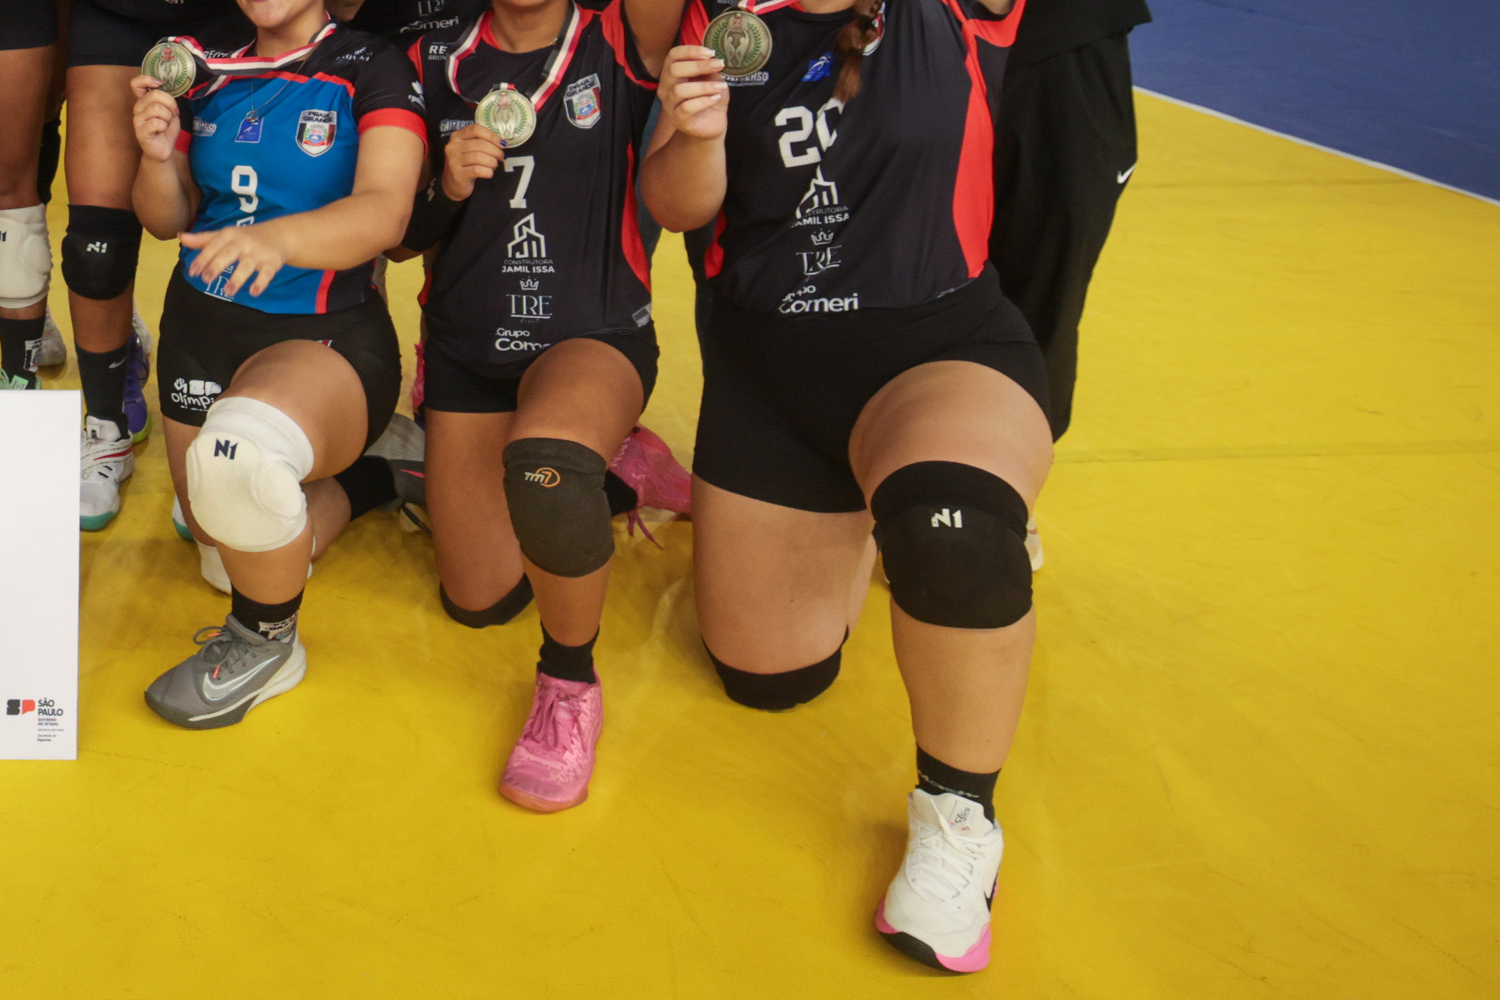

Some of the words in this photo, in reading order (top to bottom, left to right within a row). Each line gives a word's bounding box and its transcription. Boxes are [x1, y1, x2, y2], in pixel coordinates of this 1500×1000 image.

[231, 165, 259, 213] 9
[503, 155, 535, 209] 7
[824, 213, 850, 224] ISSA
[501, 265, 530, 273] JAMIL
[506, 294, 553, 316] TRE
[779, 293, 859, 314] Comeri
[496, 327, 531, 337] Grupo
[495, 338, 552, 351] Com
[213, 438, 239, 460] N1
[930, 507, 963, 528] N1
[38, 697, 55, 708] SÃO
[38, 708, 64, 717] PAULO
